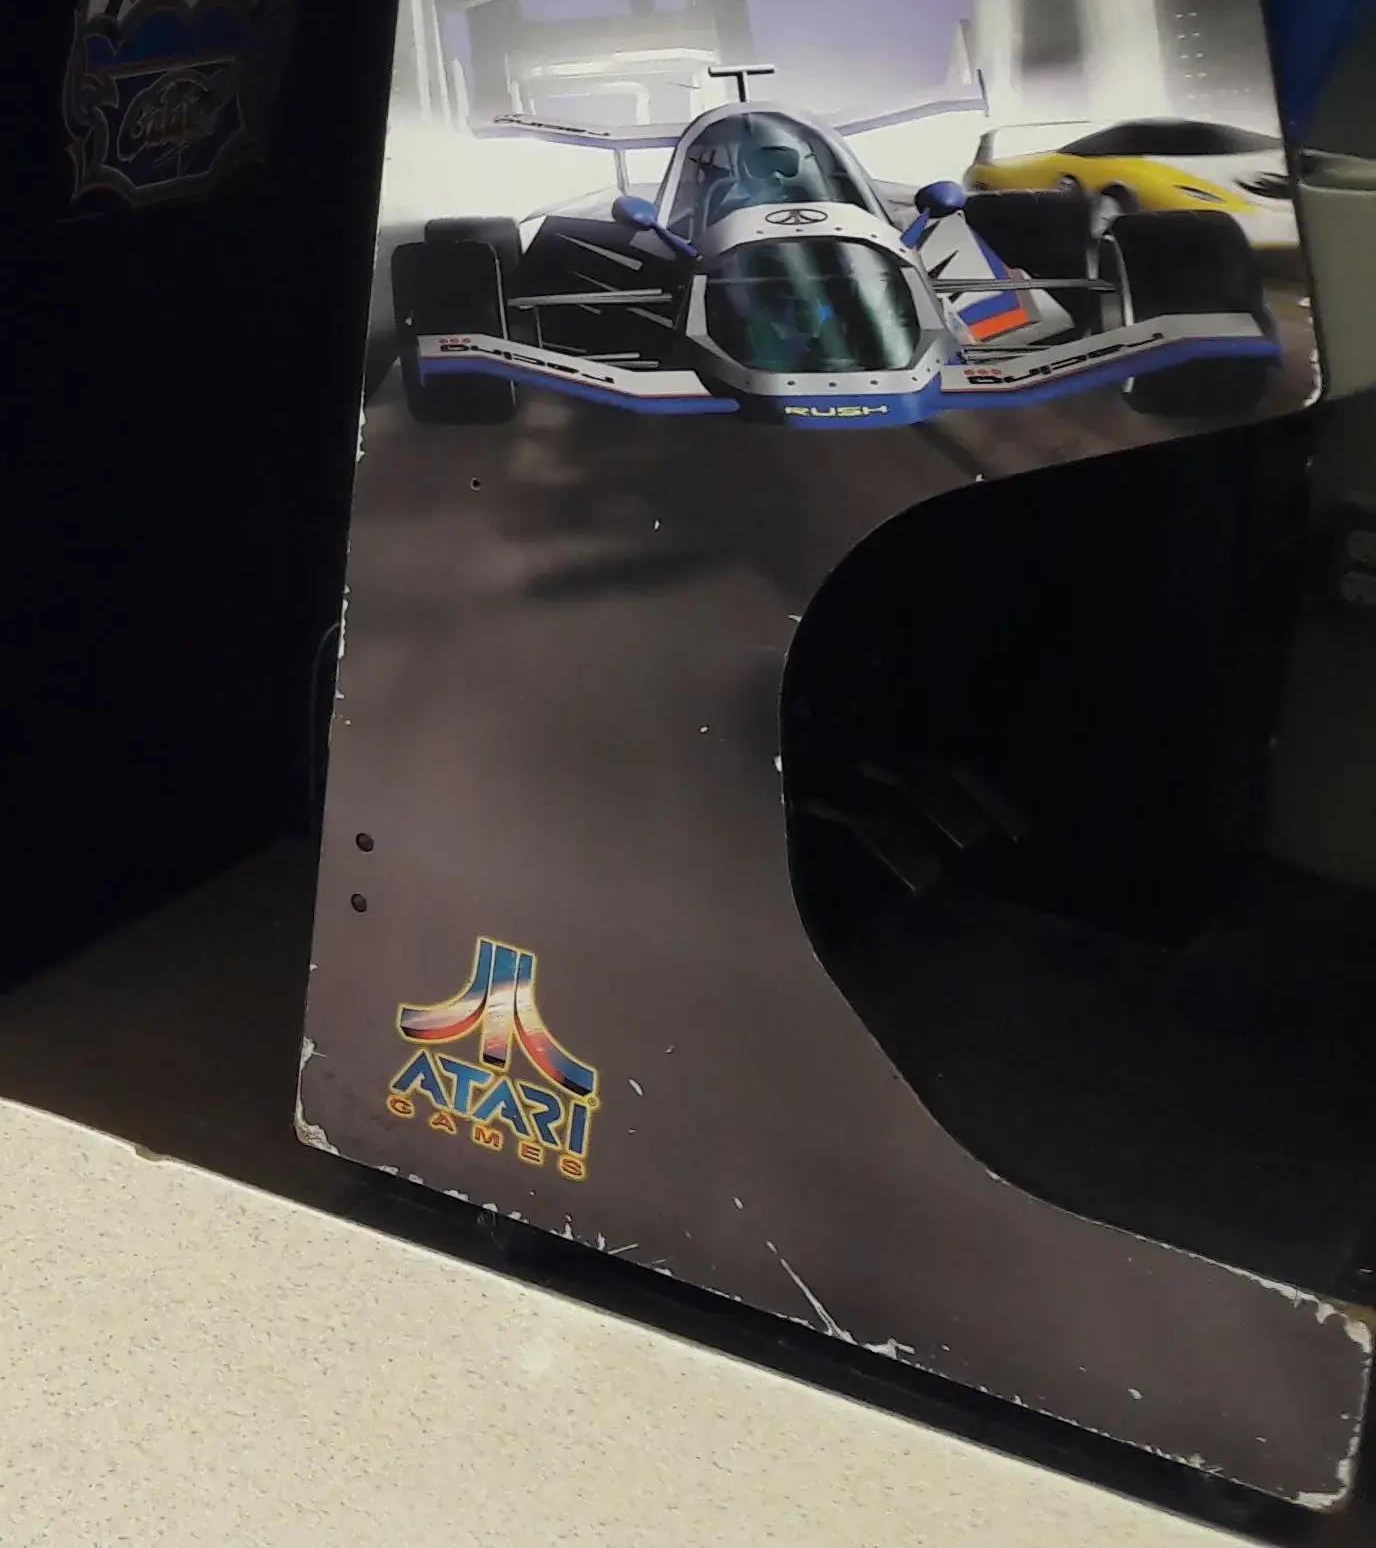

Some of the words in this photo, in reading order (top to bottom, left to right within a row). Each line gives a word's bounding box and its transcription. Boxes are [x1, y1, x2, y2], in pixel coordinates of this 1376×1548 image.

[784, 405, 889, 418] RUSH
[387, 1094, 587, 1180] GAMES
[388, 1049, 591, 1158] ATARI
